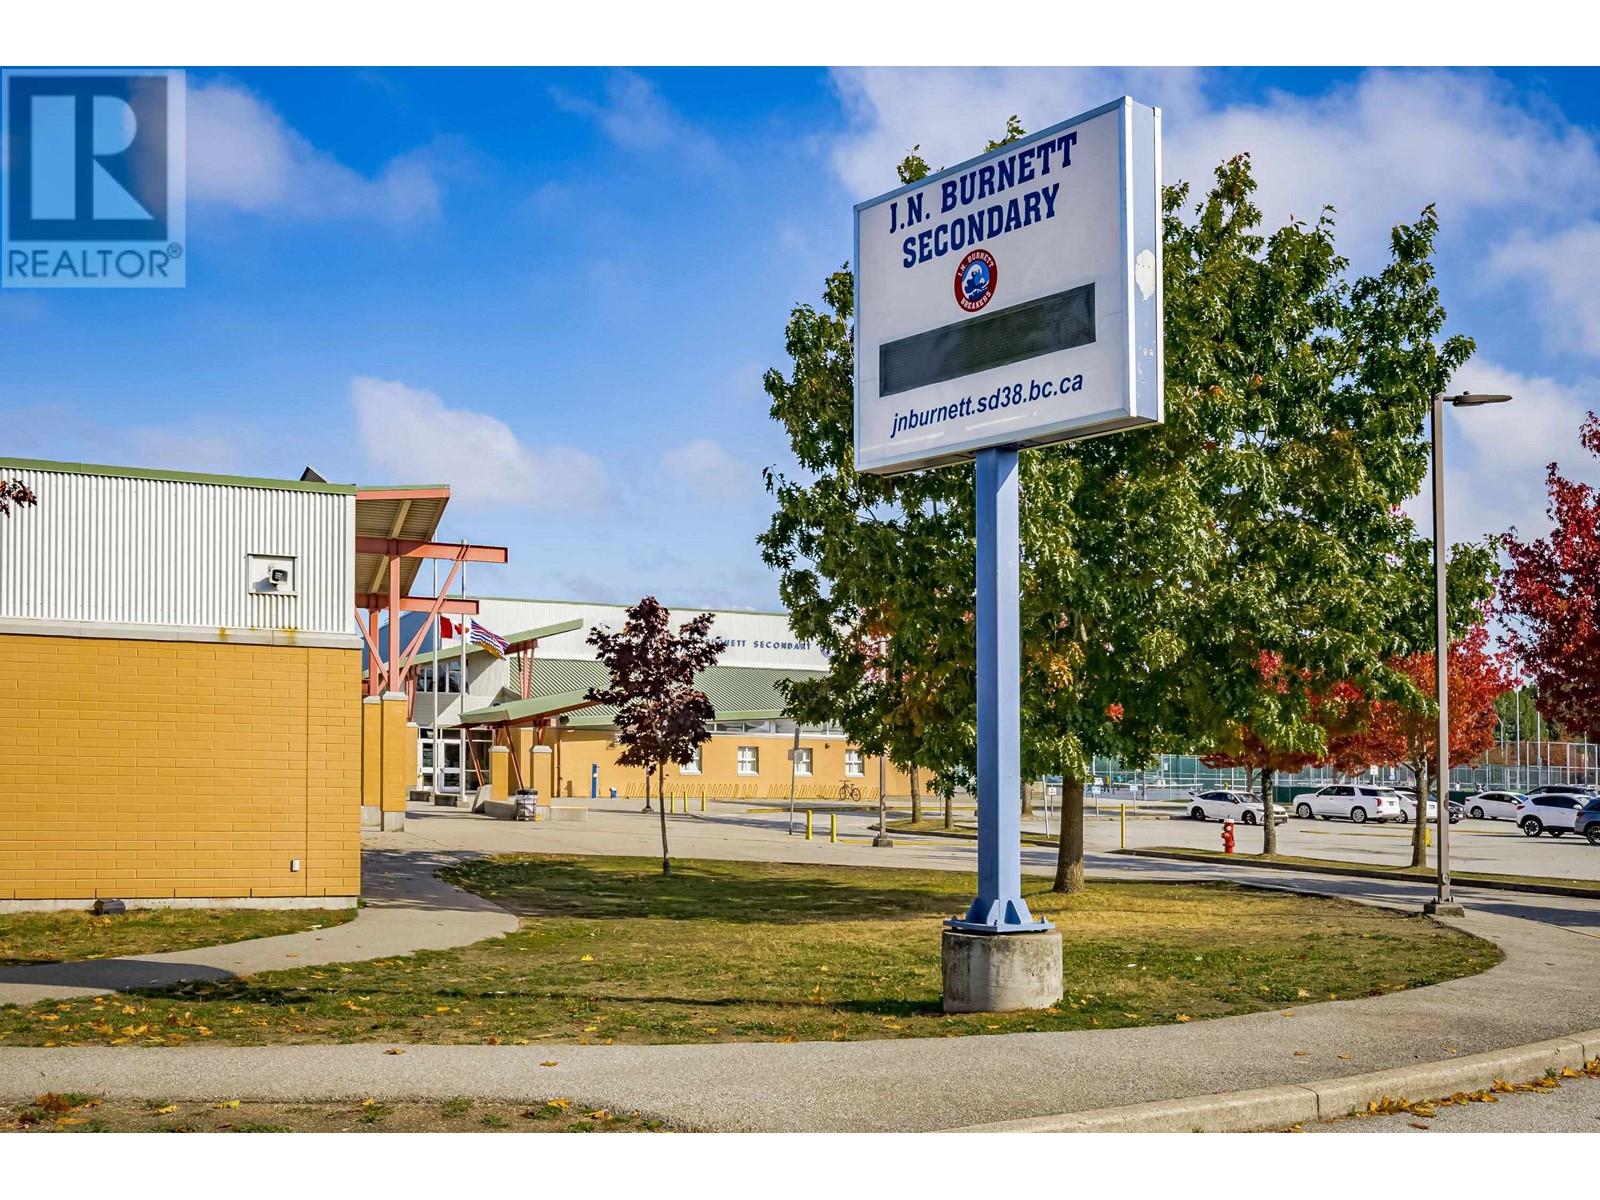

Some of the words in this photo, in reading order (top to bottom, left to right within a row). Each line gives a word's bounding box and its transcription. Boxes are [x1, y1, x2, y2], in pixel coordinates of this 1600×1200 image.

[889, 191, 930, 234] J.N.
[940, 131, 1077, 214] BURNETT
[902, 182, 1060, 269] SECONDARY
[890, 373, 1084, 439] jnburnett.sd38.bc.ca
